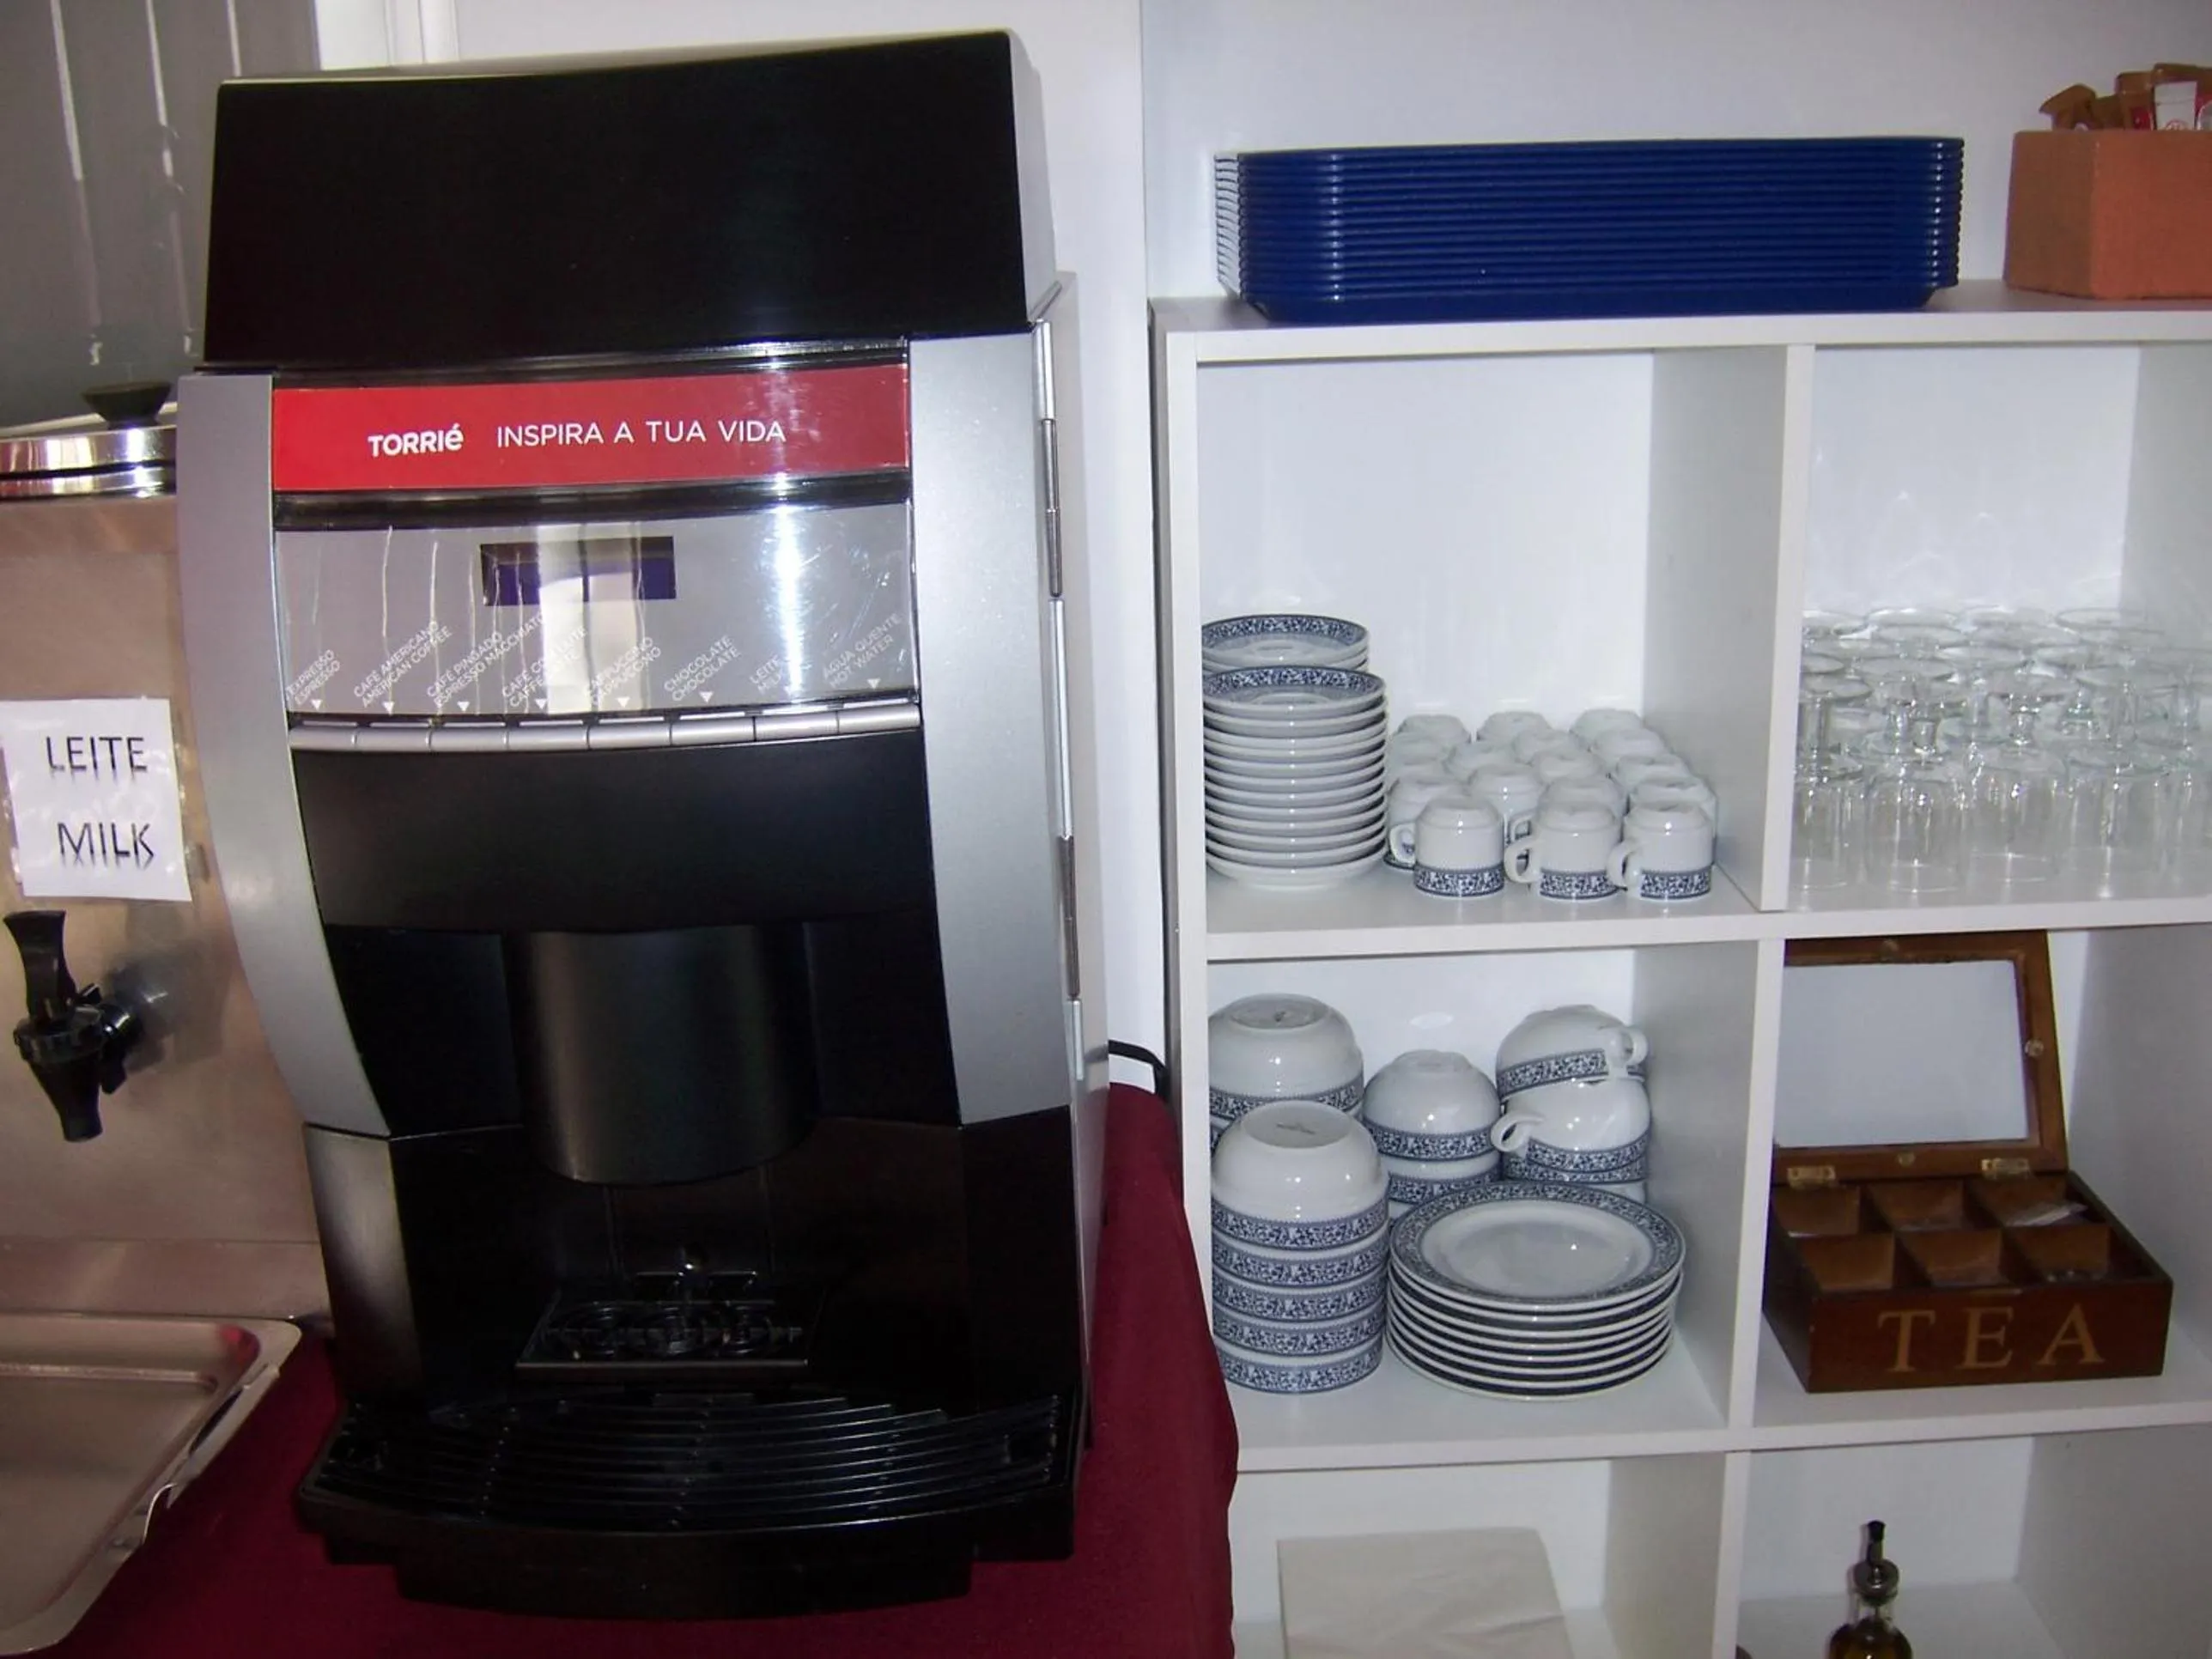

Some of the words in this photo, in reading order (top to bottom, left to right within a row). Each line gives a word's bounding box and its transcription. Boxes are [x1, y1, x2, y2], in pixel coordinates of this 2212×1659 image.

[497, 422, 604, 447] INSPIRA
[613, 421, 635, 443] A
[646, 420, 707, 443] TUA
[718, 420, 787, 442] VIDA
[662, 633, 733, 693] CHOCOLATE
[671, 646, 740, 702] CHOCOLATE
[46, 736, 148, 773] LEITE
[57, 822, 155, 860] MILK
[1876, 1303, 2105, 1373] TEA
